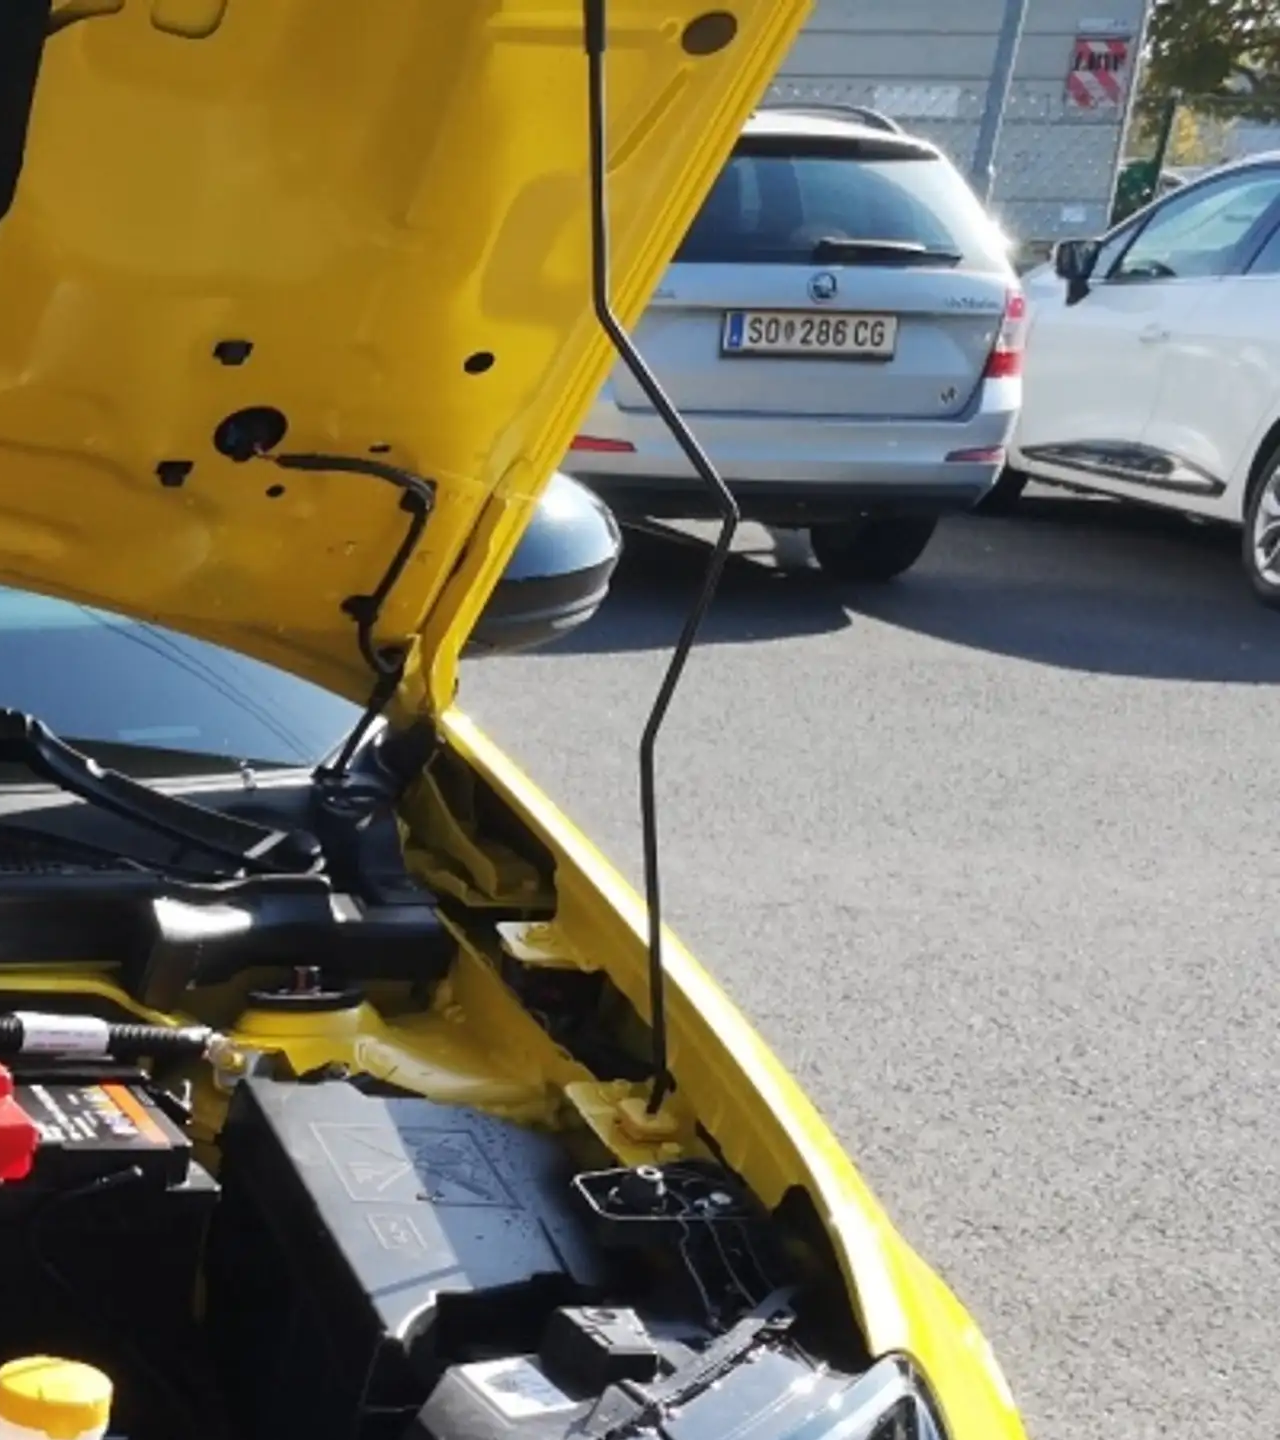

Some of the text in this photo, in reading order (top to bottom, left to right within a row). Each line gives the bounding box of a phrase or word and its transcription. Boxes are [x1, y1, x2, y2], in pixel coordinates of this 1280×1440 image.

[748, 317, 886, 348] SO 286 CG
